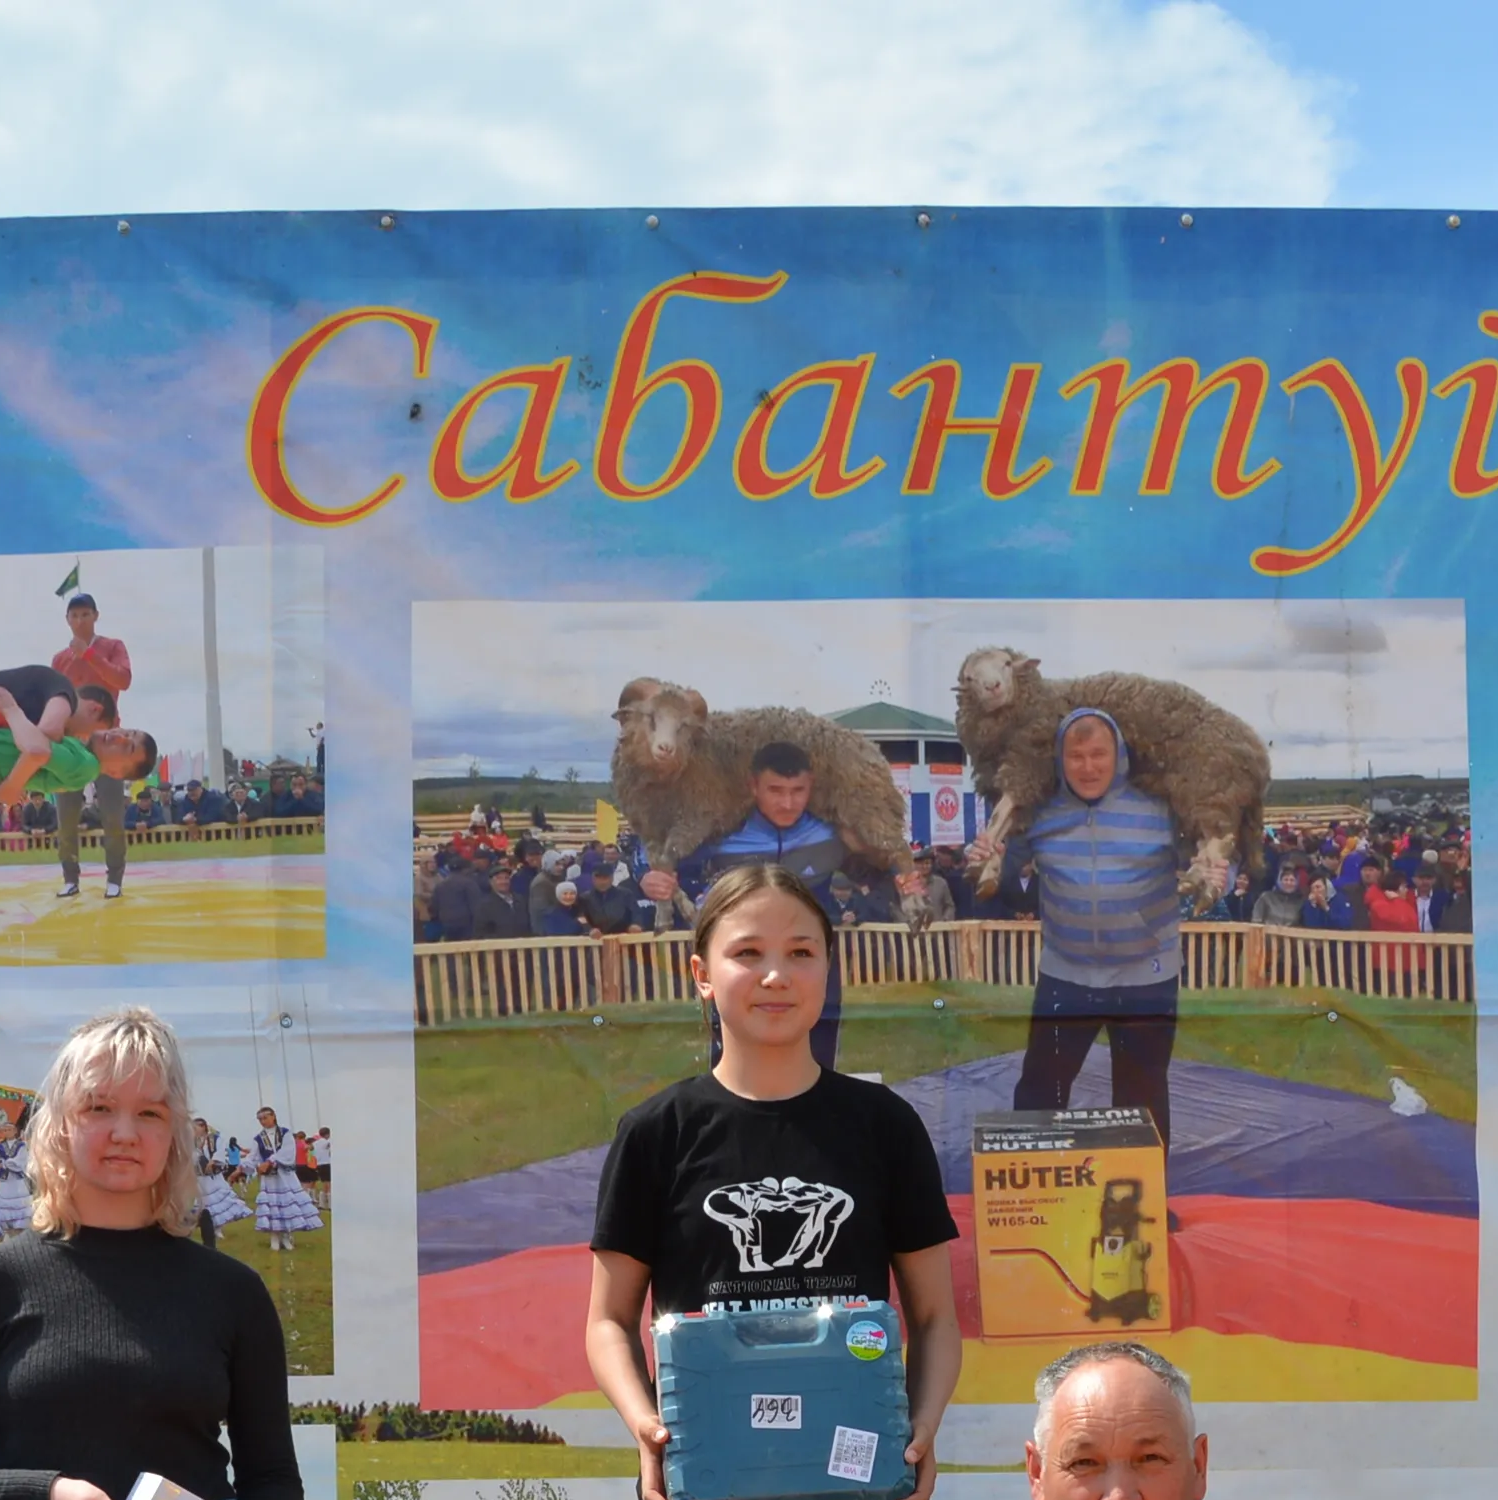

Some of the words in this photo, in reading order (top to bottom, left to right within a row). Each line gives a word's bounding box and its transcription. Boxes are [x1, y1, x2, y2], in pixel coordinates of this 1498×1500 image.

[984, 1161, 1098, 1192] HÜTER
[987, 1215, 1049, 1228] W165-QL
[708, 1276, 800, 1296] NATIONAL
[803, 1274, 858, 1290] TEAM
